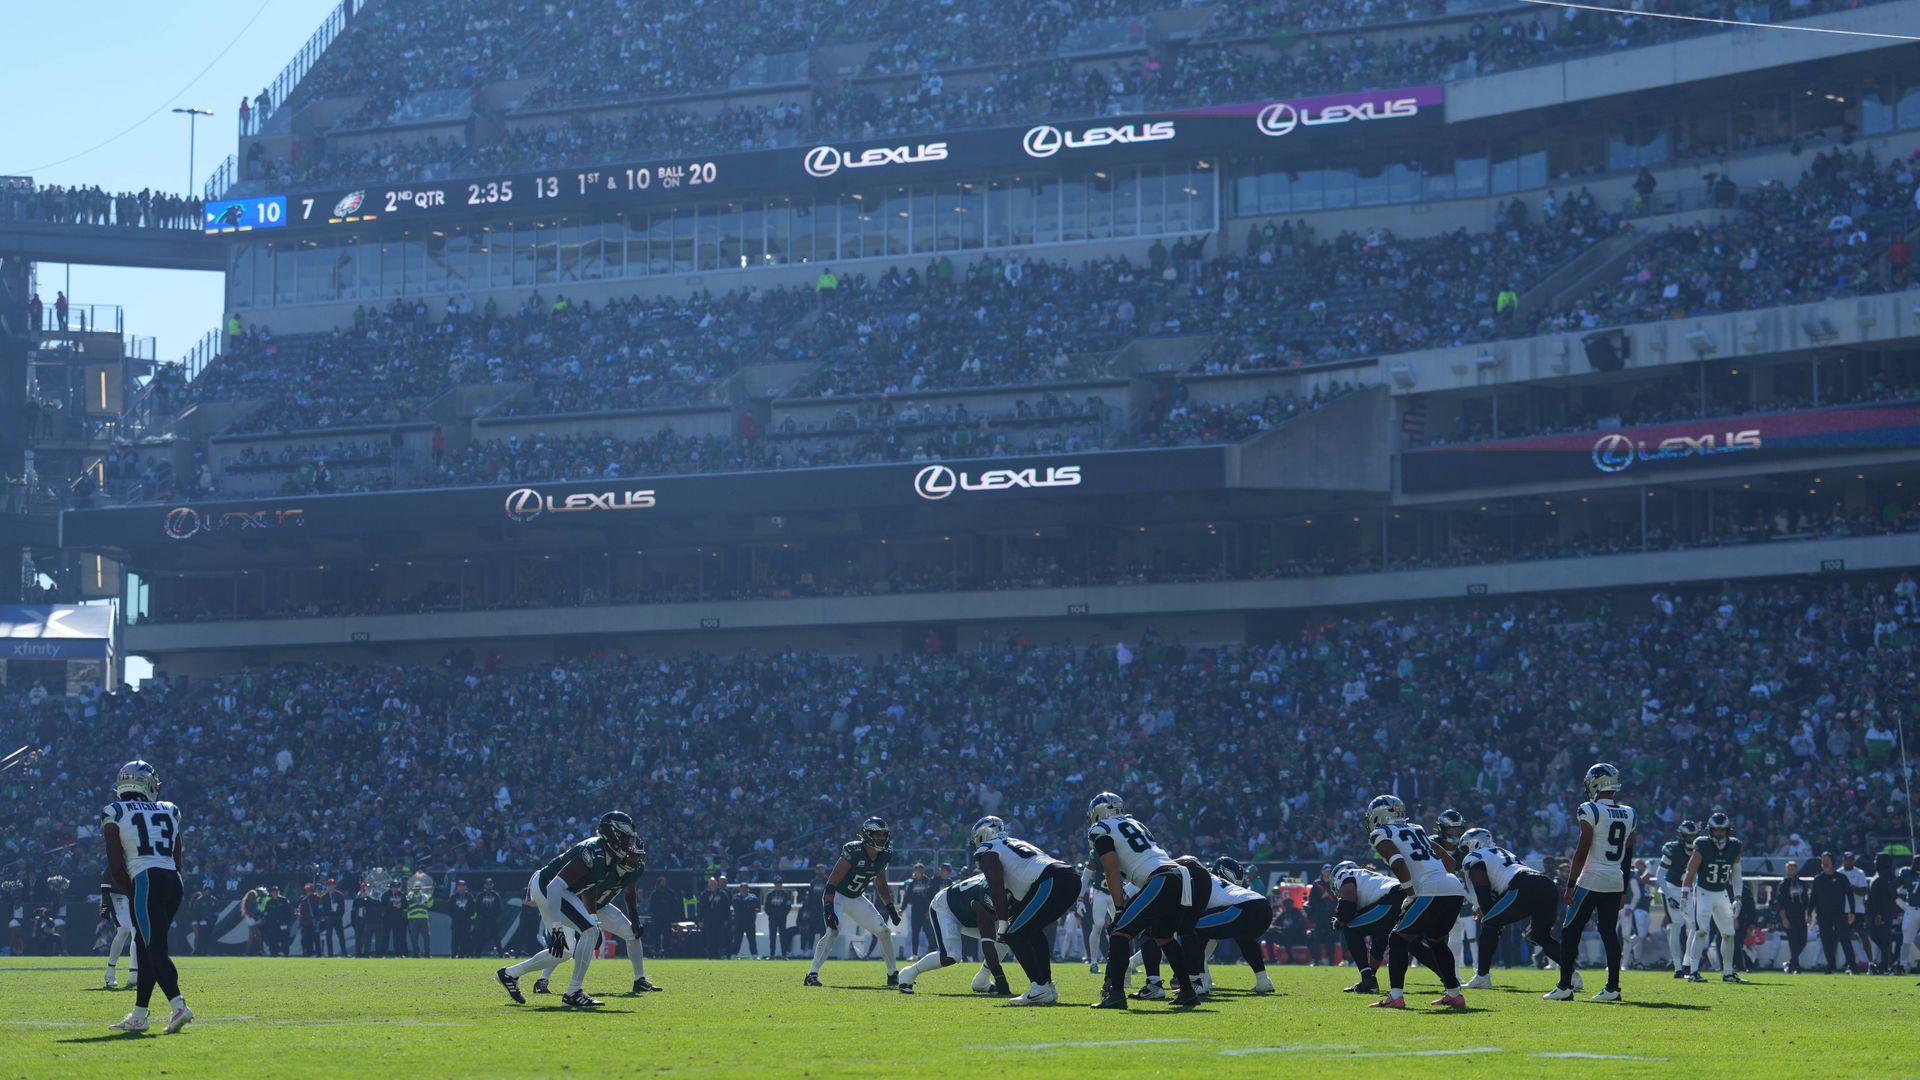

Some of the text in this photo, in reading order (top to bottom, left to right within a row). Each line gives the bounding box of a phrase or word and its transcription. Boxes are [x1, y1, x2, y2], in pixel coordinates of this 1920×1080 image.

[1301, 98, 1418, 126] LEXUS
[1064, 121, 1175, 148] LEXUS
[843, 142, 948, 168] LEXUS
[577, 168, 650, 195] 1ST & 10
[658, 165, 685, 179] BALL
[662, 177, 680, 189] ON
[688, 162, 717, 186] 20
[467, 181, 513, 205] 2:35
[535, 176, 559, 198] 13
[257, 201, 281, 224] 10
[302, 198, 315, 220] 7
[384, 190, 445, 212] 2ND QTR
[1637, 429, 1762, 461] LEXUS
[959, 465, 1082, 491] LEXUS
[546, 489, 656, 513] LEXUS
[13, 640, 61, 658] xfinity
[1606, 808, 1629, 820] YOUNG
[131, 812, 174, 857] 13
[1605, 821, 1627, 862] 9
[1706, 863, 1732, 884] 33
